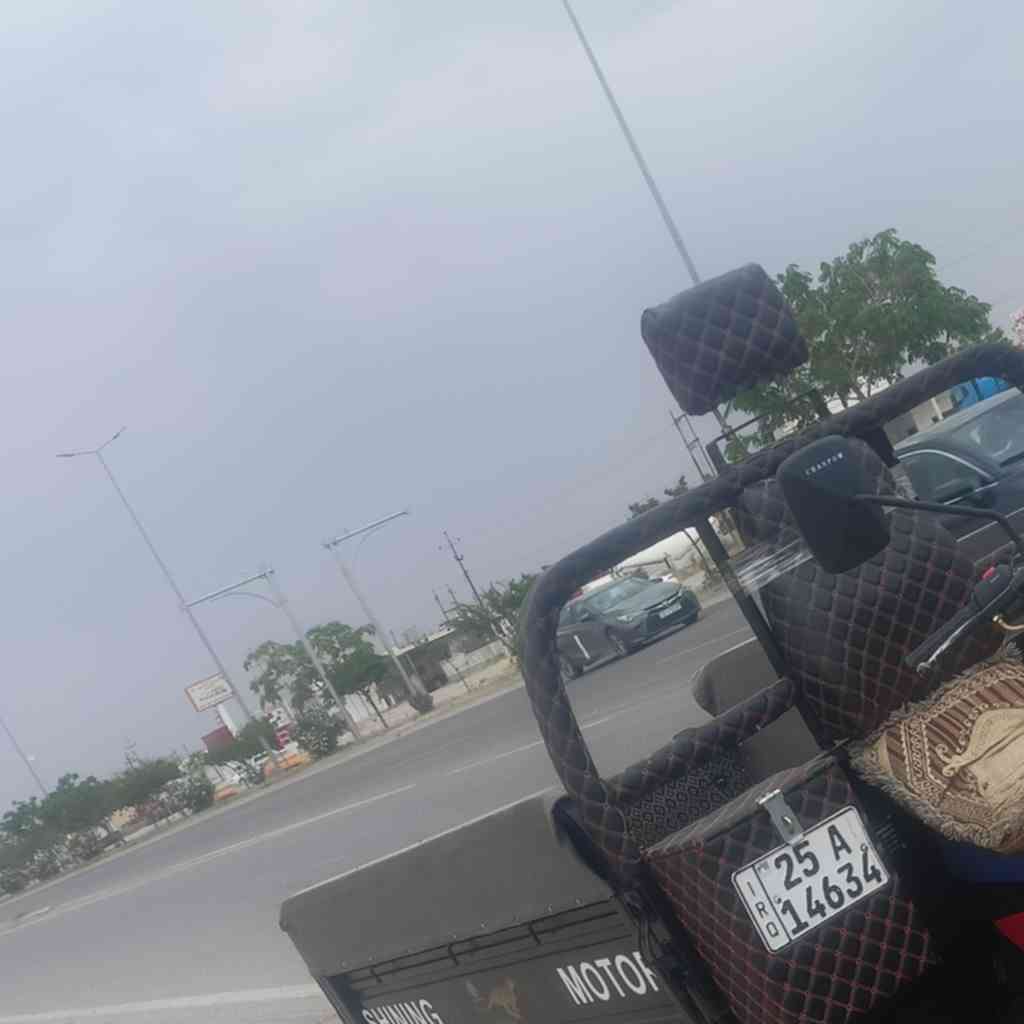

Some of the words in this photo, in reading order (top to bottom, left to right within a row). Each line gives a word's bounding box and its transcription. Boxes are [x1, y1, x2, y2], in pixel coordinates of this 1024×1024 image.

[774, 840, 820, 890] 25
[827, 824, 853, 861] A
[780, 851, 883, 935] 14634
